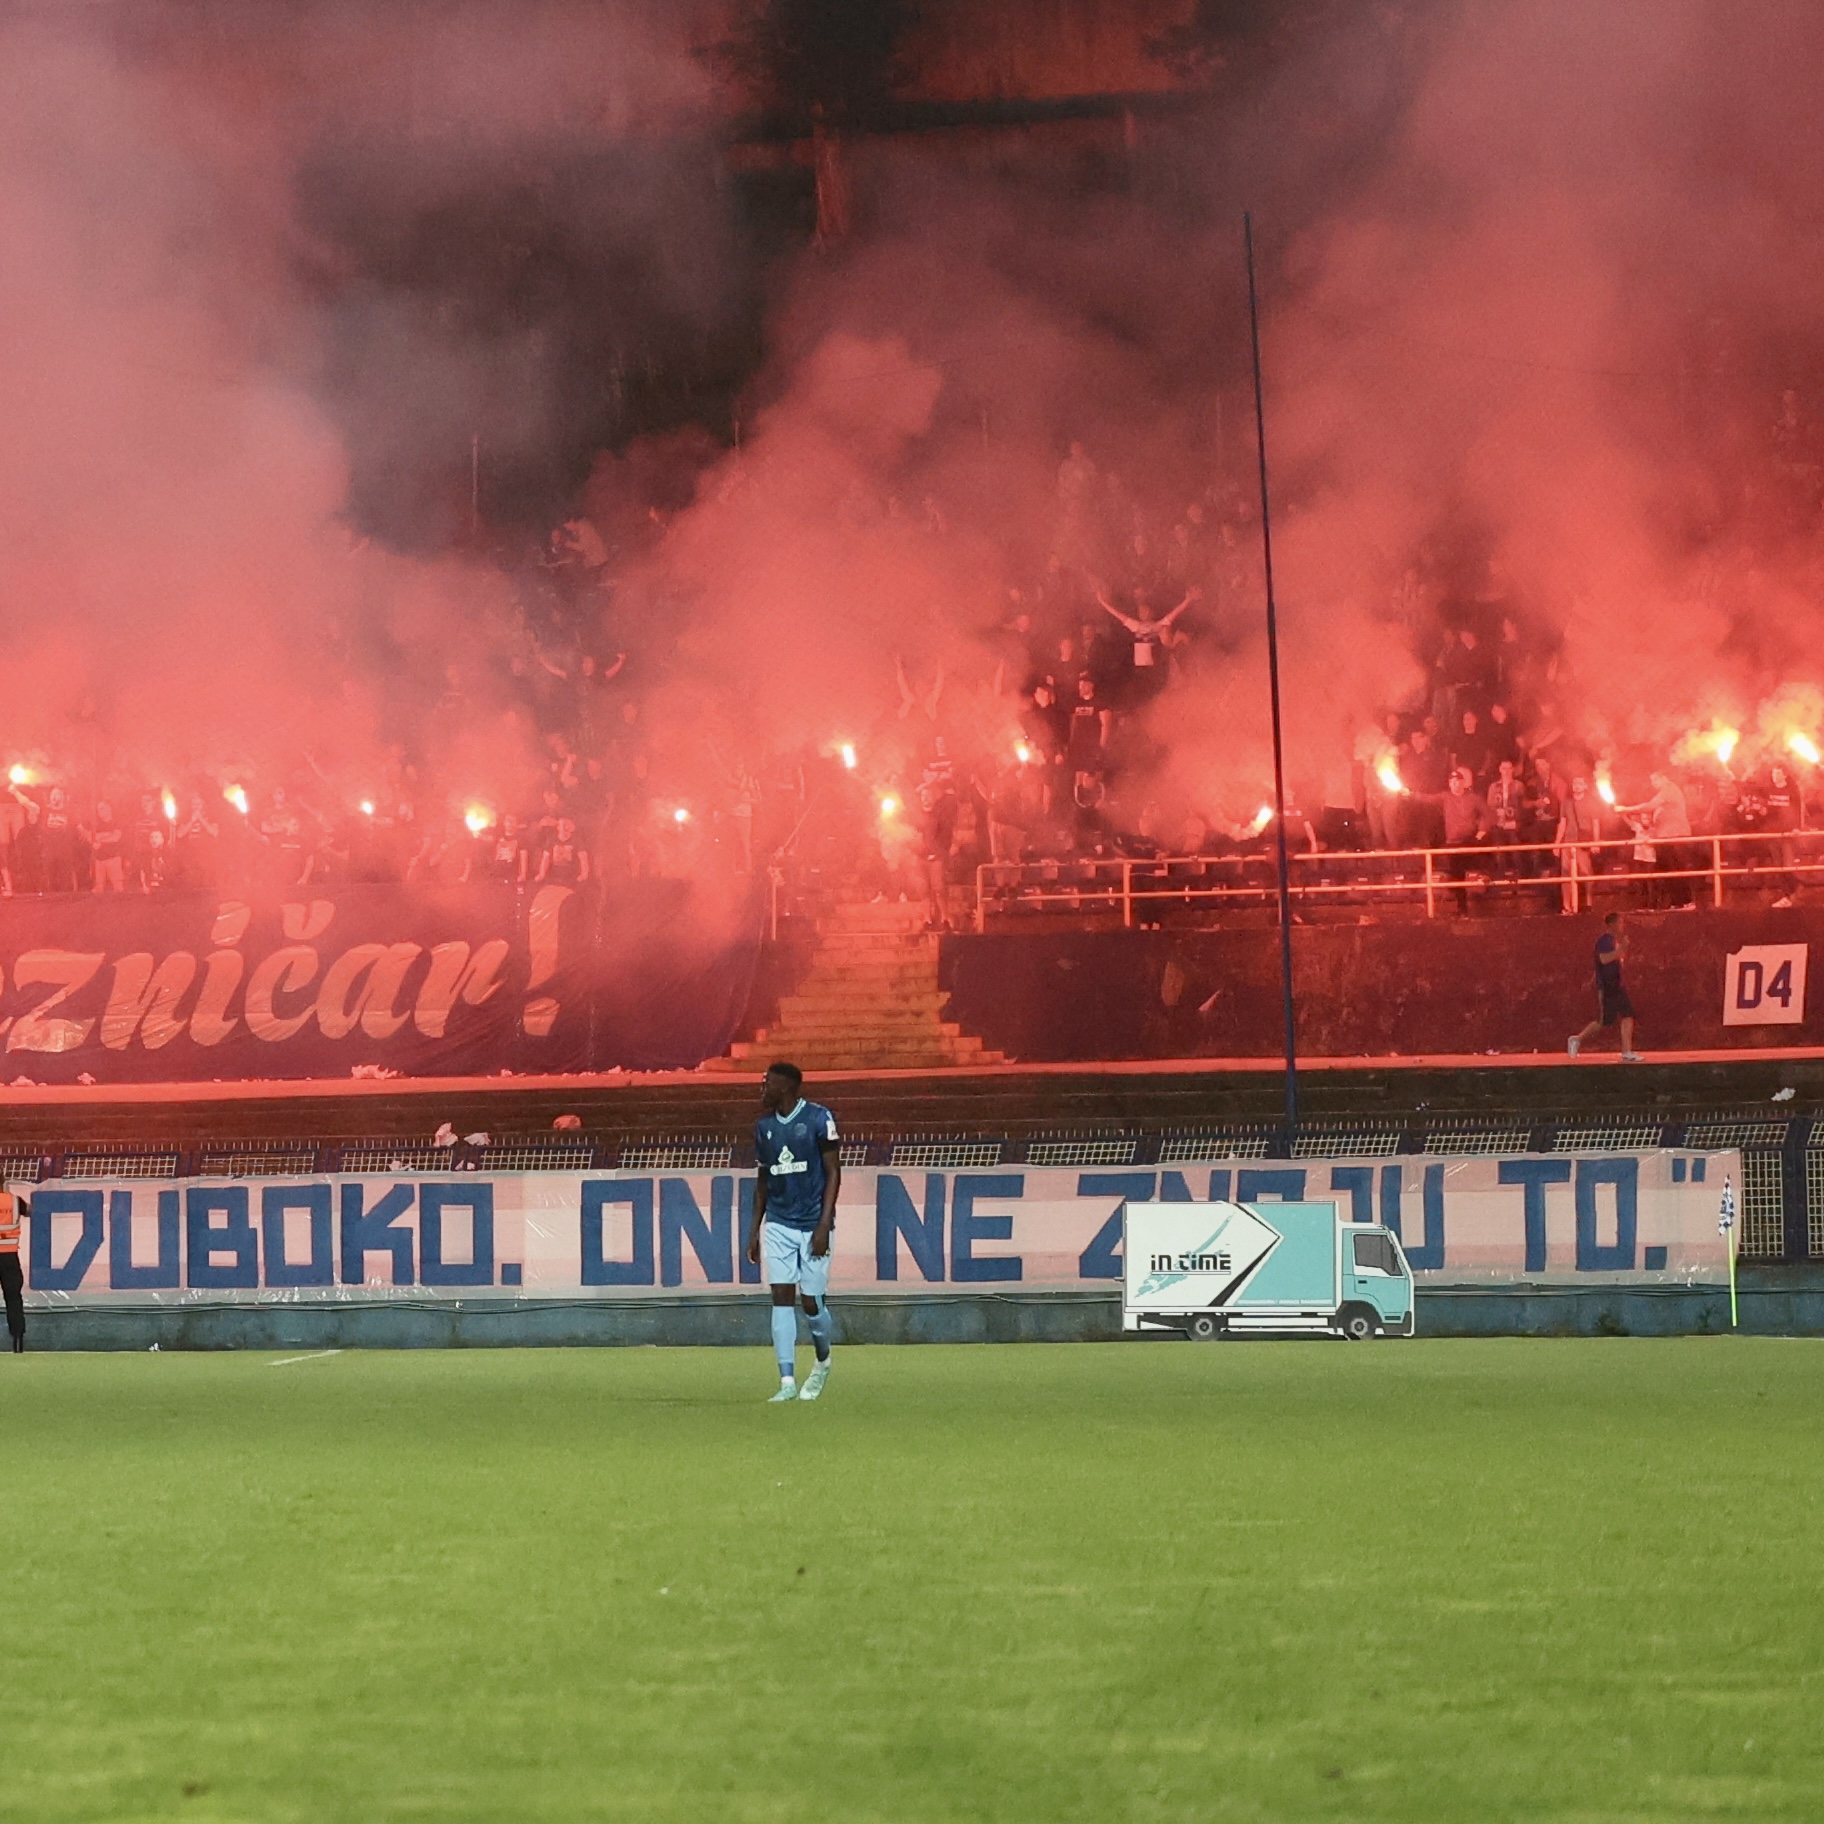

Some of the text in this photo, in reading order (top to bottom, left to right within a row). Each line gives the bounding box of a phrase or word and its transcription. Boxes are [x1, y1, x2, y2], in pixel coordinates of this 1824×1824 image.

[1736, 959, 1793, 1010] D4
[29, 1180, 523, 1292] DUBOKO.
[875, 1173, 1025, 1282] NE
